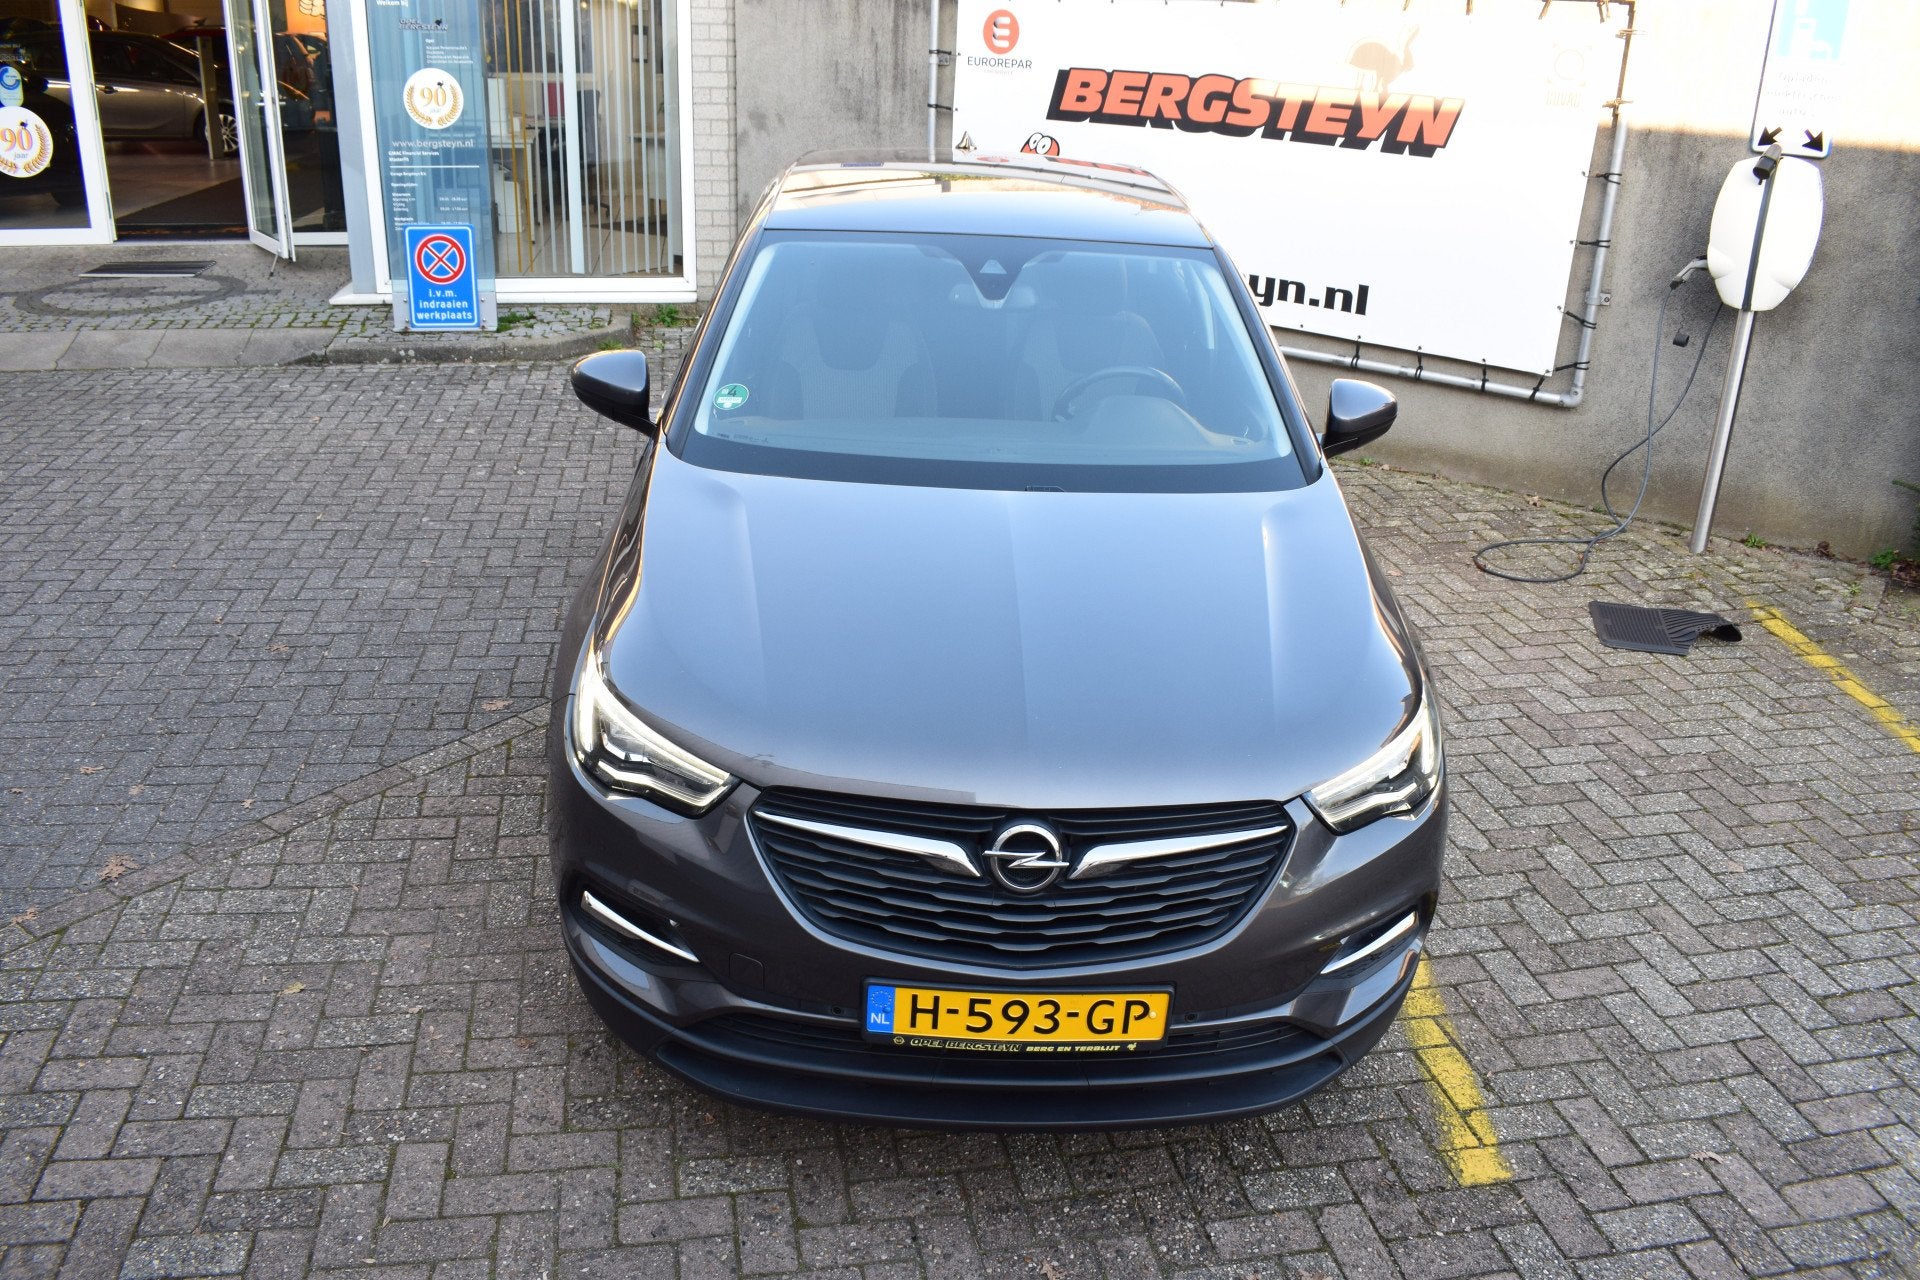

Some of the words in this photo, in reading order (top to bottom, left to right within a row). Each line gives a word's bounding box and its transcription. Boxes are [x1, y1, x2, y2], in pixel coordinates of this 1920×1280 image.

[967, 56, 1033, 69] EUROREPAR
[420, 86, 447, 107] 90
[1048, 66, 1466, 158] BERGSTEYN
[0, 127, 33, 152] 90
[392, 139, 474, 149] www.bergsteyn.nl
[428, 288, 457, 297] i.v.m.
[1247, 273, 1370, 316] yn.nl
[419, 300, 468, 309] indraaien
[416, 310, 473, 321] werkplaats
[727, 385, 738, 397] 4
[870, 1012, 890, 1025] NL
[910, 993, 1151, 1035] H-593-GP
[910, 1038, 945, 1048] OPEL
[945, 1040, 1023, 1052] BERGSTEYN
